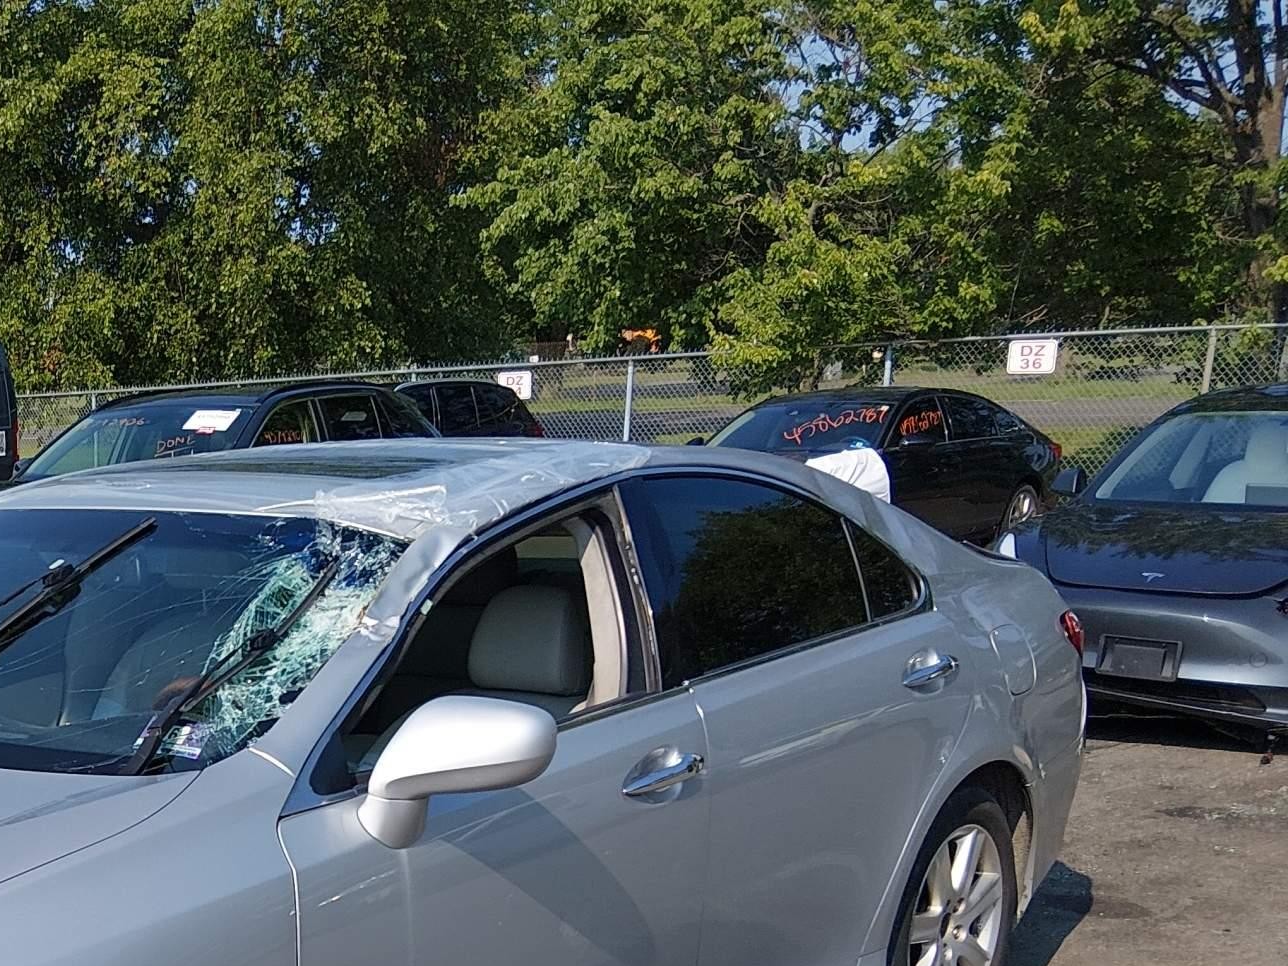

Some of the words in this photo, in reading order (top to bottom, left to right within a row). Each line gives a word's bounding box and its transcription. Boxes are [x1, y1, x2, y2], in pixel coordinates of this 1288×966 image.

[1020, 345, 1046, 357] DZ
[1020, 358, 1042, 369] 36
[506, 376, 524, 386] DZ
[156, 435, 196, 453] DONE
